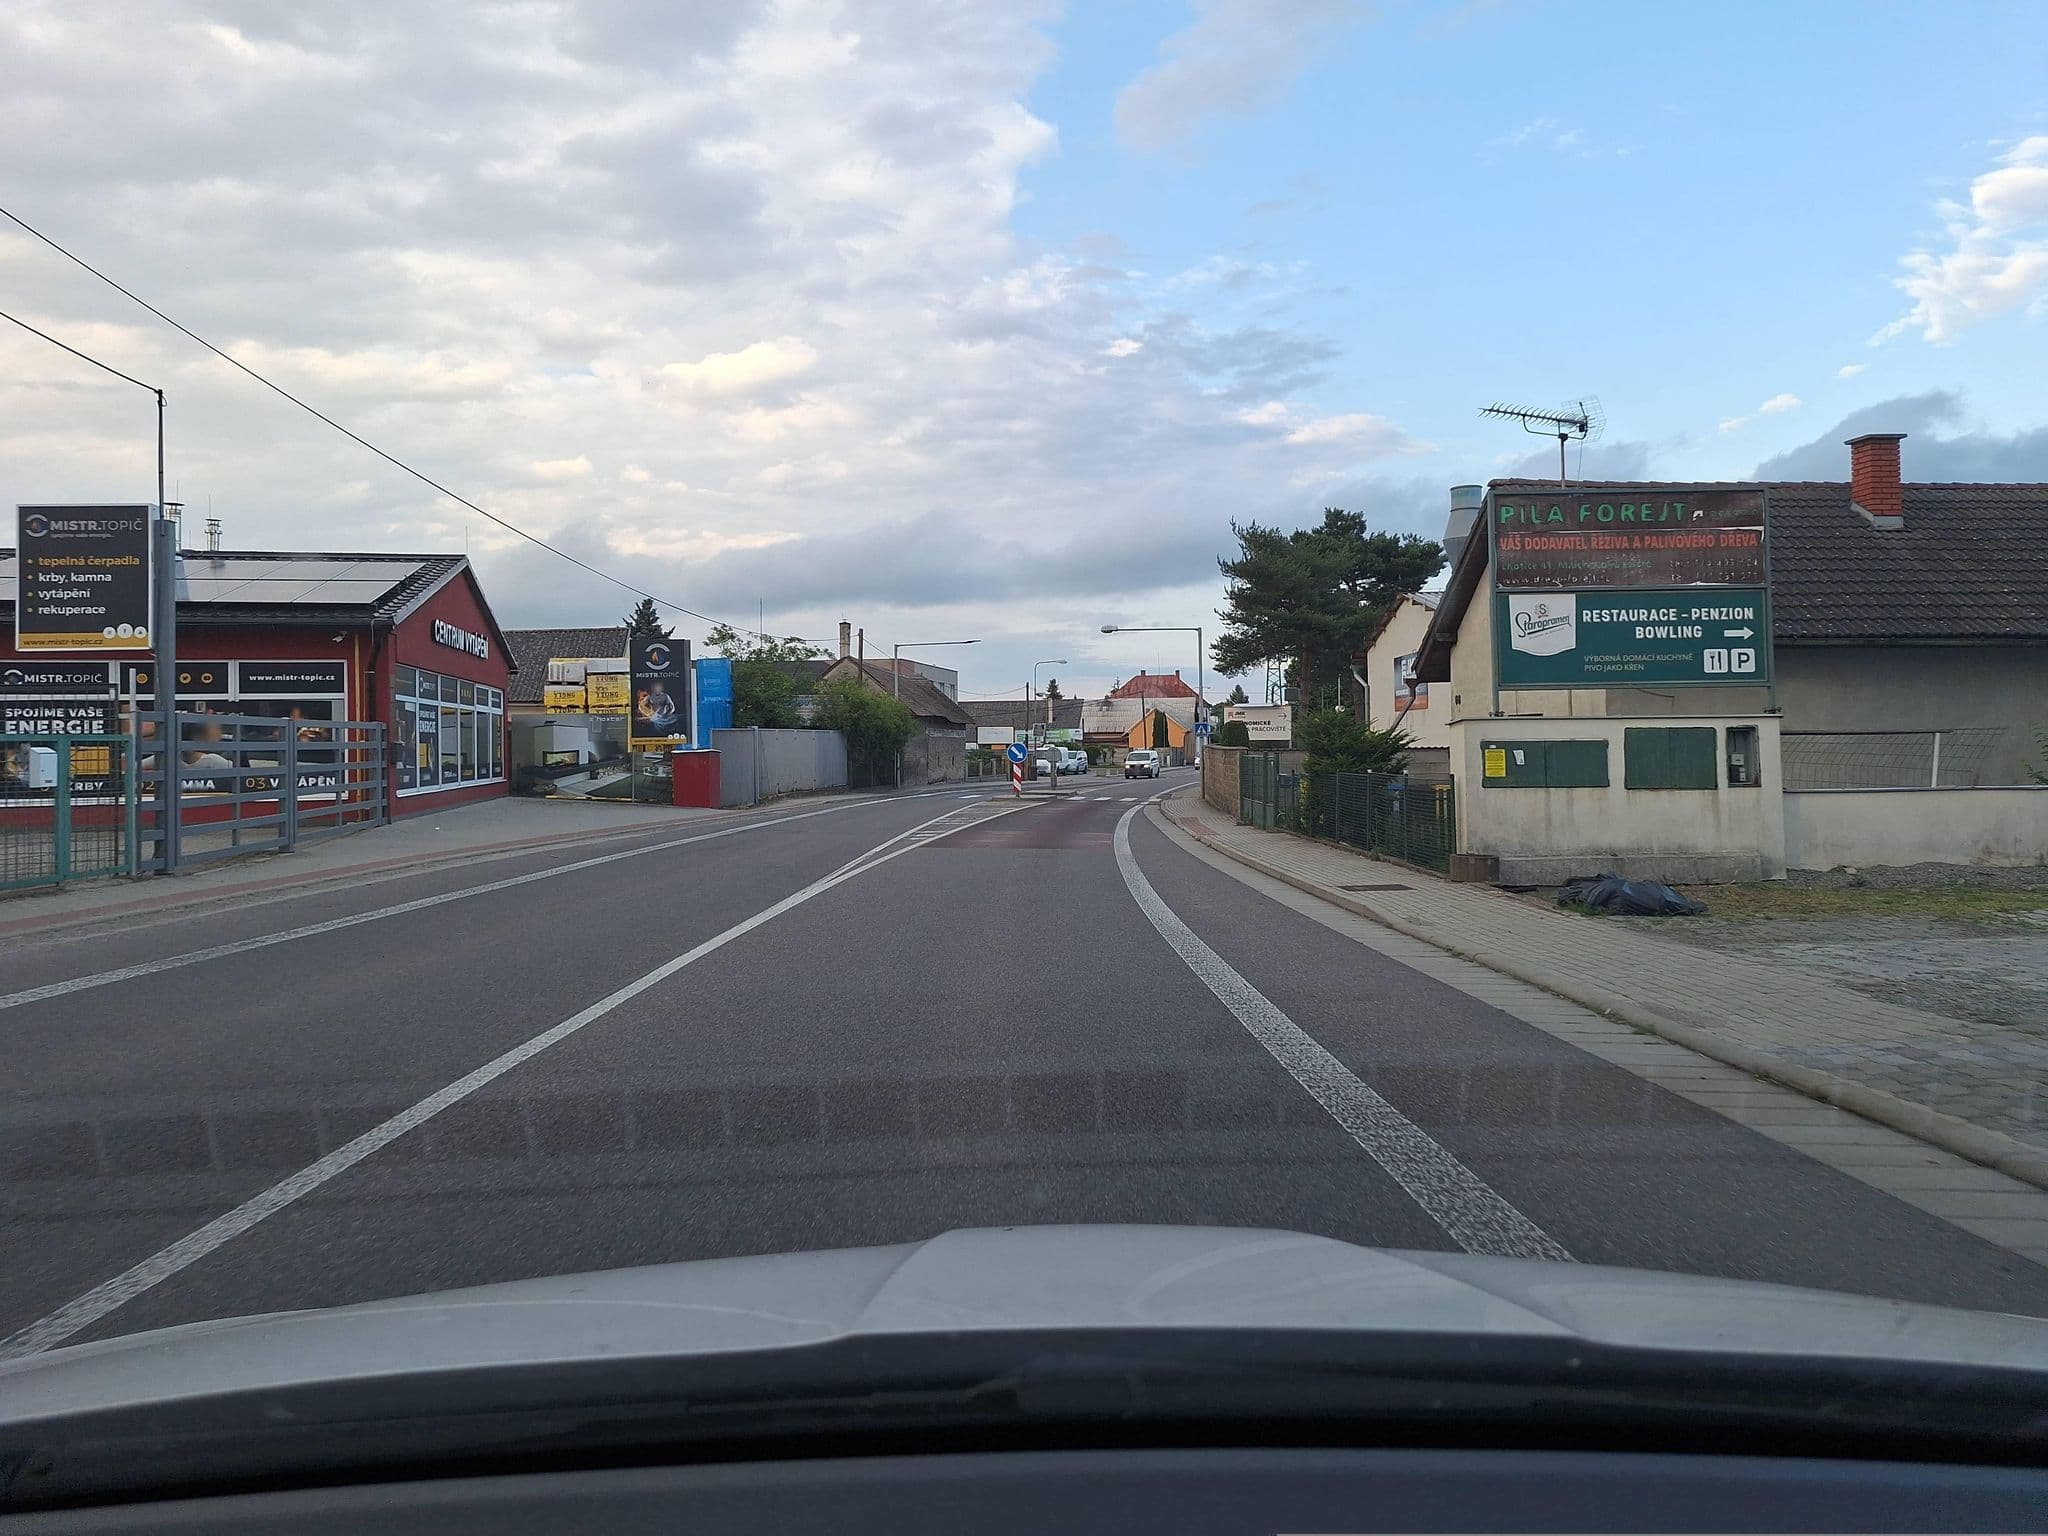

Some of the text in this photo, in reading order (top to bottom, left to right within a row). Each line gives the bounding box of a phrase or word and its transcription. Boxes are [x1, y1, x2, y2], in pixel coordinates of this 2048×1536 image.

[1500, 503, 1686, 523] PILA FOREJT
[1525, 536, 1587, 550] DODAVATEL
[1591, 532, 1630, 549] ŘEZIVA
[1633, 535, 1642, 548] A
[1644, 532, 1715, 548] PALIVOVÉHO
[1720, 531, 1757, 547] DŘEVA
[38, 555, 140, 567] tepelná čerpadla
[38, 573, 112, 584] krby, kamna
[38, 588, 91, 600] vytápění
[38, 604, 106, 616] rekuperace
[1582, 608, 1678, 622] RESTAURACE
[1691, 607, 1754, 620] PENZION
[1515, 612, 1571, 637] Staropramen
[434, 619, 464, 650] CENTRUM
[1635, 625, 1703, 639] BOWLING
[1584, 664, 1603, 672] PIVO
[1604, 664, 1623, 672] JAKO
[249, 673, 335, 682] www.mistr-topic.cz
[595, 691, 619, 699] YTONG
[5, 706, 104, 717] SPOJÍME VAŠE
[5, 719, 104, 734] ENERGIE
